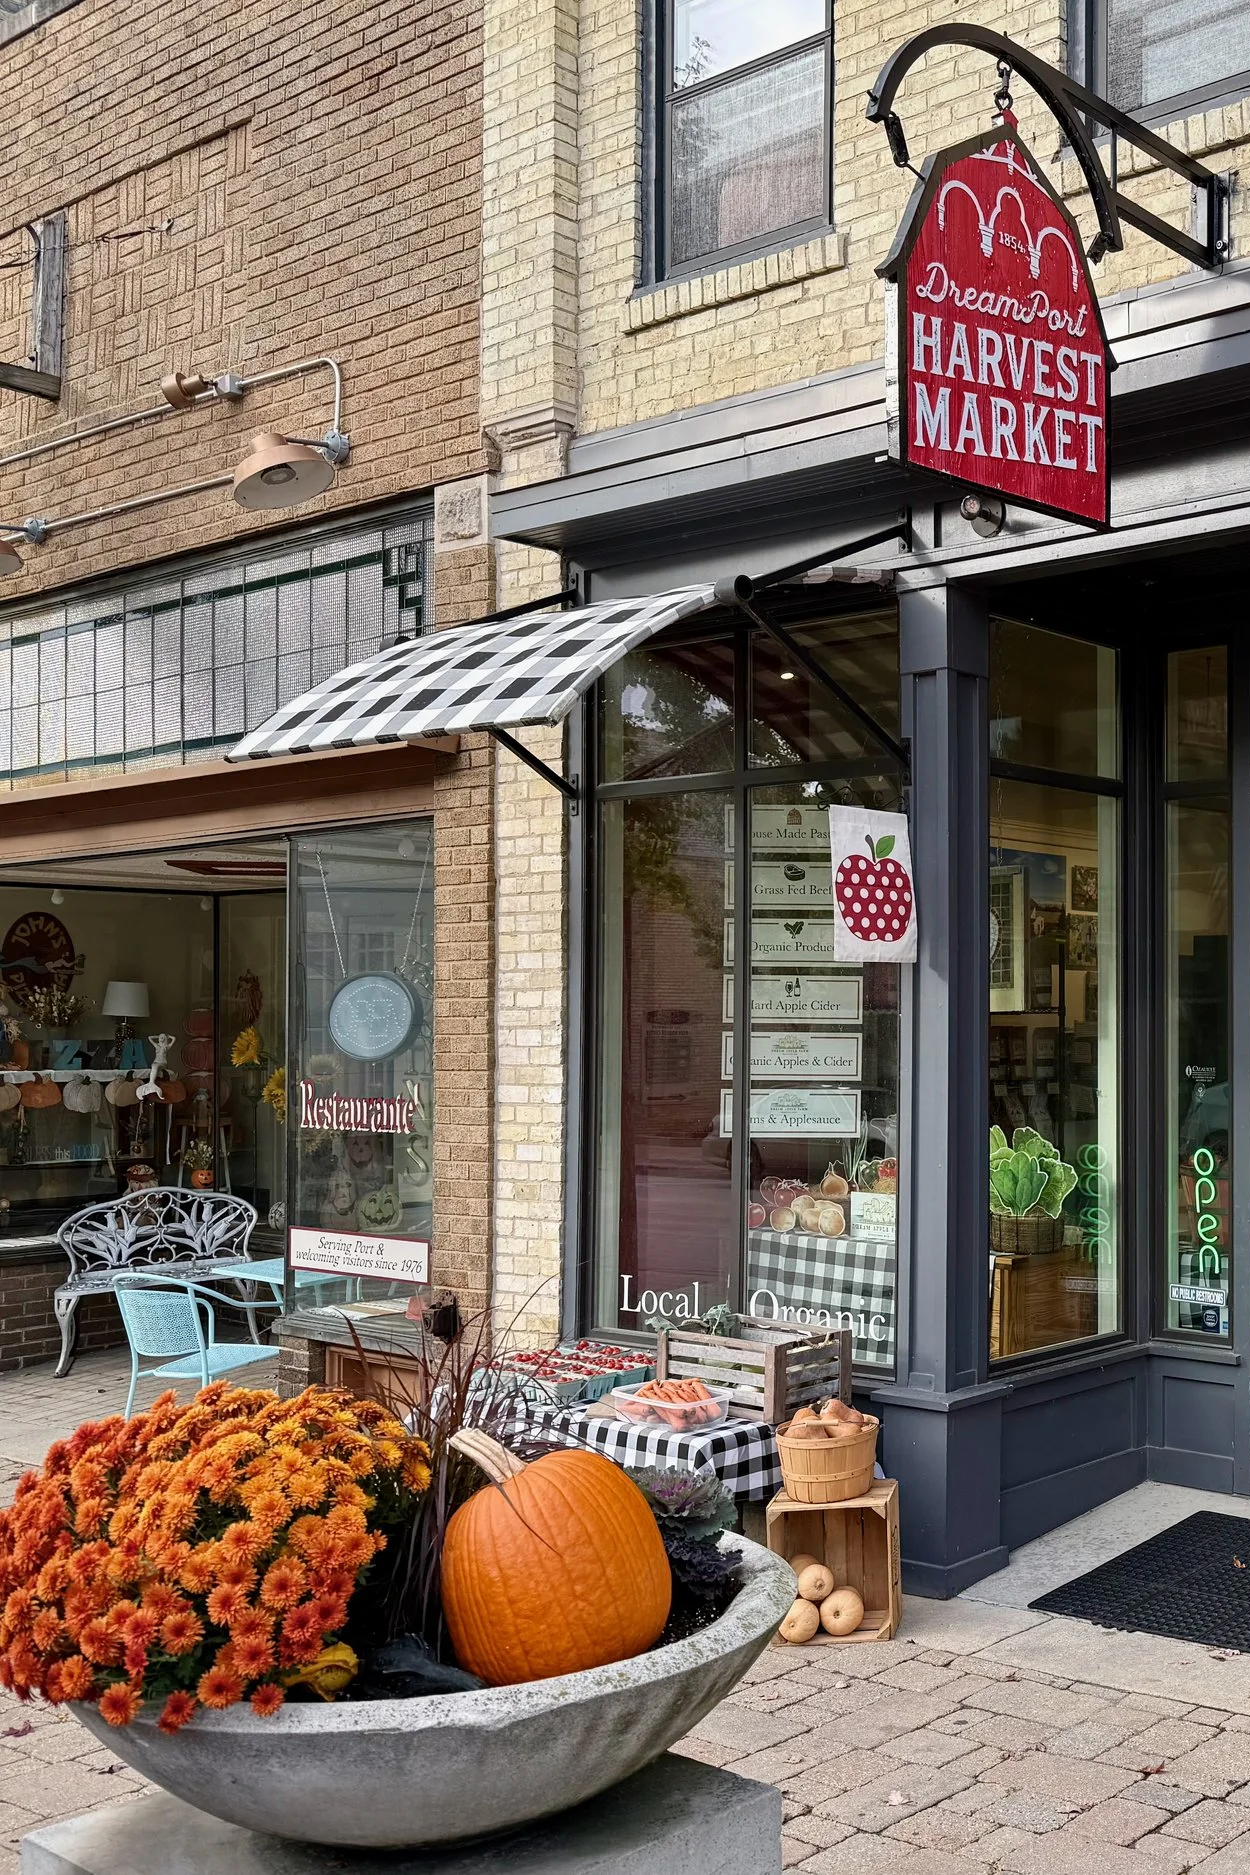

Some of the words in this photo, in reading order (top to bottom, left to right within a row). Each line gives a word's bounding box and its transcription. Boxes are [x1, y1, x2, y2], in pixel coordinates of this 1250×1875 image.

[998, 231, 1024, 253] 1854
[912, 311, 1103, 406] HARVEST
[913, 381, 1103, 473] MARKET
[752, 831, 773, 839] use
[776, 828, 807, 839] Made
[810, 828, 831, 839] Past
[754, 884, 784, 895] Grass
[787, 884, 806, 895] Fed
[775, 1000, 808, 1013] Apple
[810, 1000, 841, 1011] Cider
[774, 1056, 809, 1069] Apples
[812, 1056, 821, 1066] &
[823, 1056, 853, 1067] Cider
[768, 1114, 777, 1125] &
[780, 1114, 841, 1127] Applesauce
[1193, 1148, 1220, 1274] open
[318, 1236, 352, 1254] Serving
[354, 1240, 374, 1255] Port
[376, 1243, 385, 1256] &
[296, 1249, 340, 1267] welcoming
[342, 1254, 373, 1269] visitors
[374, 1257, 398, 1271] since
[401, 1259, 423, 1274] 1976
[620, 1274, 701, 1320] Local
[1171, 1287, 1179, 1298] NO
[1180, 1288, 1195, 1300] PUBLIC
[1195, 1290, 1224, 1305] RESTROOMS
[750, 1288, 886, 1342] Organic
